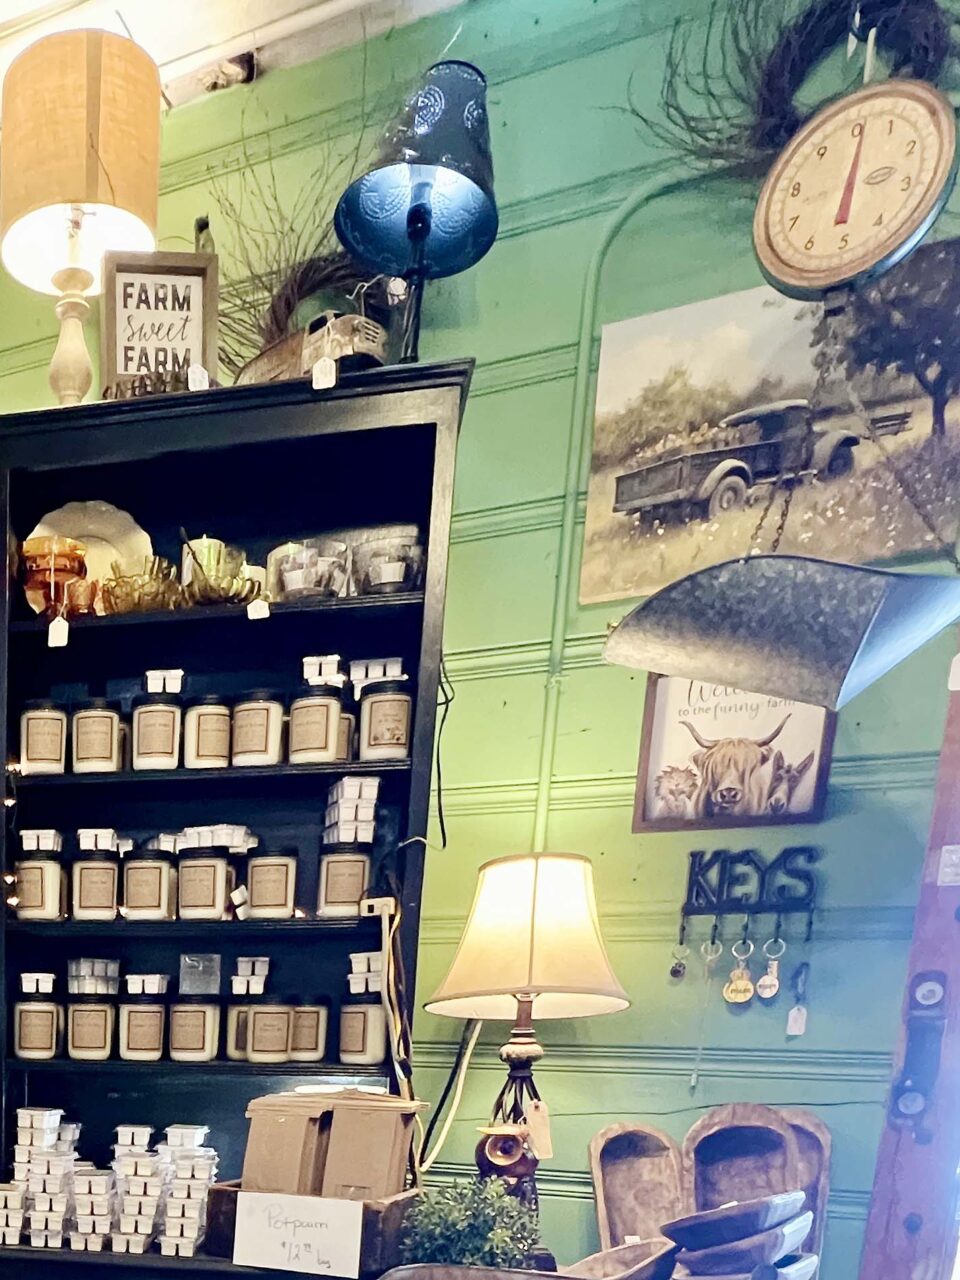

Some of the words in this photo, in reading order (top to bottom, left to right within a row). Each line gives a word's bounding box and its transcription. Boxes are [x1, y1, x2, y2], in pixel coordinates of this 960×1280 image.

[851, 122, 864, 138] 0
[887, 119, 894, 135] 1
[817, 146, 828, 160] 9
[905, 140, 917, 157] 2
[791, 182, 801, 197] 8
[900, 176, 911, 191] 3
[789, 215, 800, 231] 7
[872, 212, 883, 227] 4
[804, 235, 814, 250] 6
[838, 234, 849, 250] 5
[122, 282, 192, 312] FARM
[123, 346, 192, 374] FARM
[678, 708, 690, 717] to
[693, 706, 711, 716] the
[686, 847, 819, 904] KEYS
